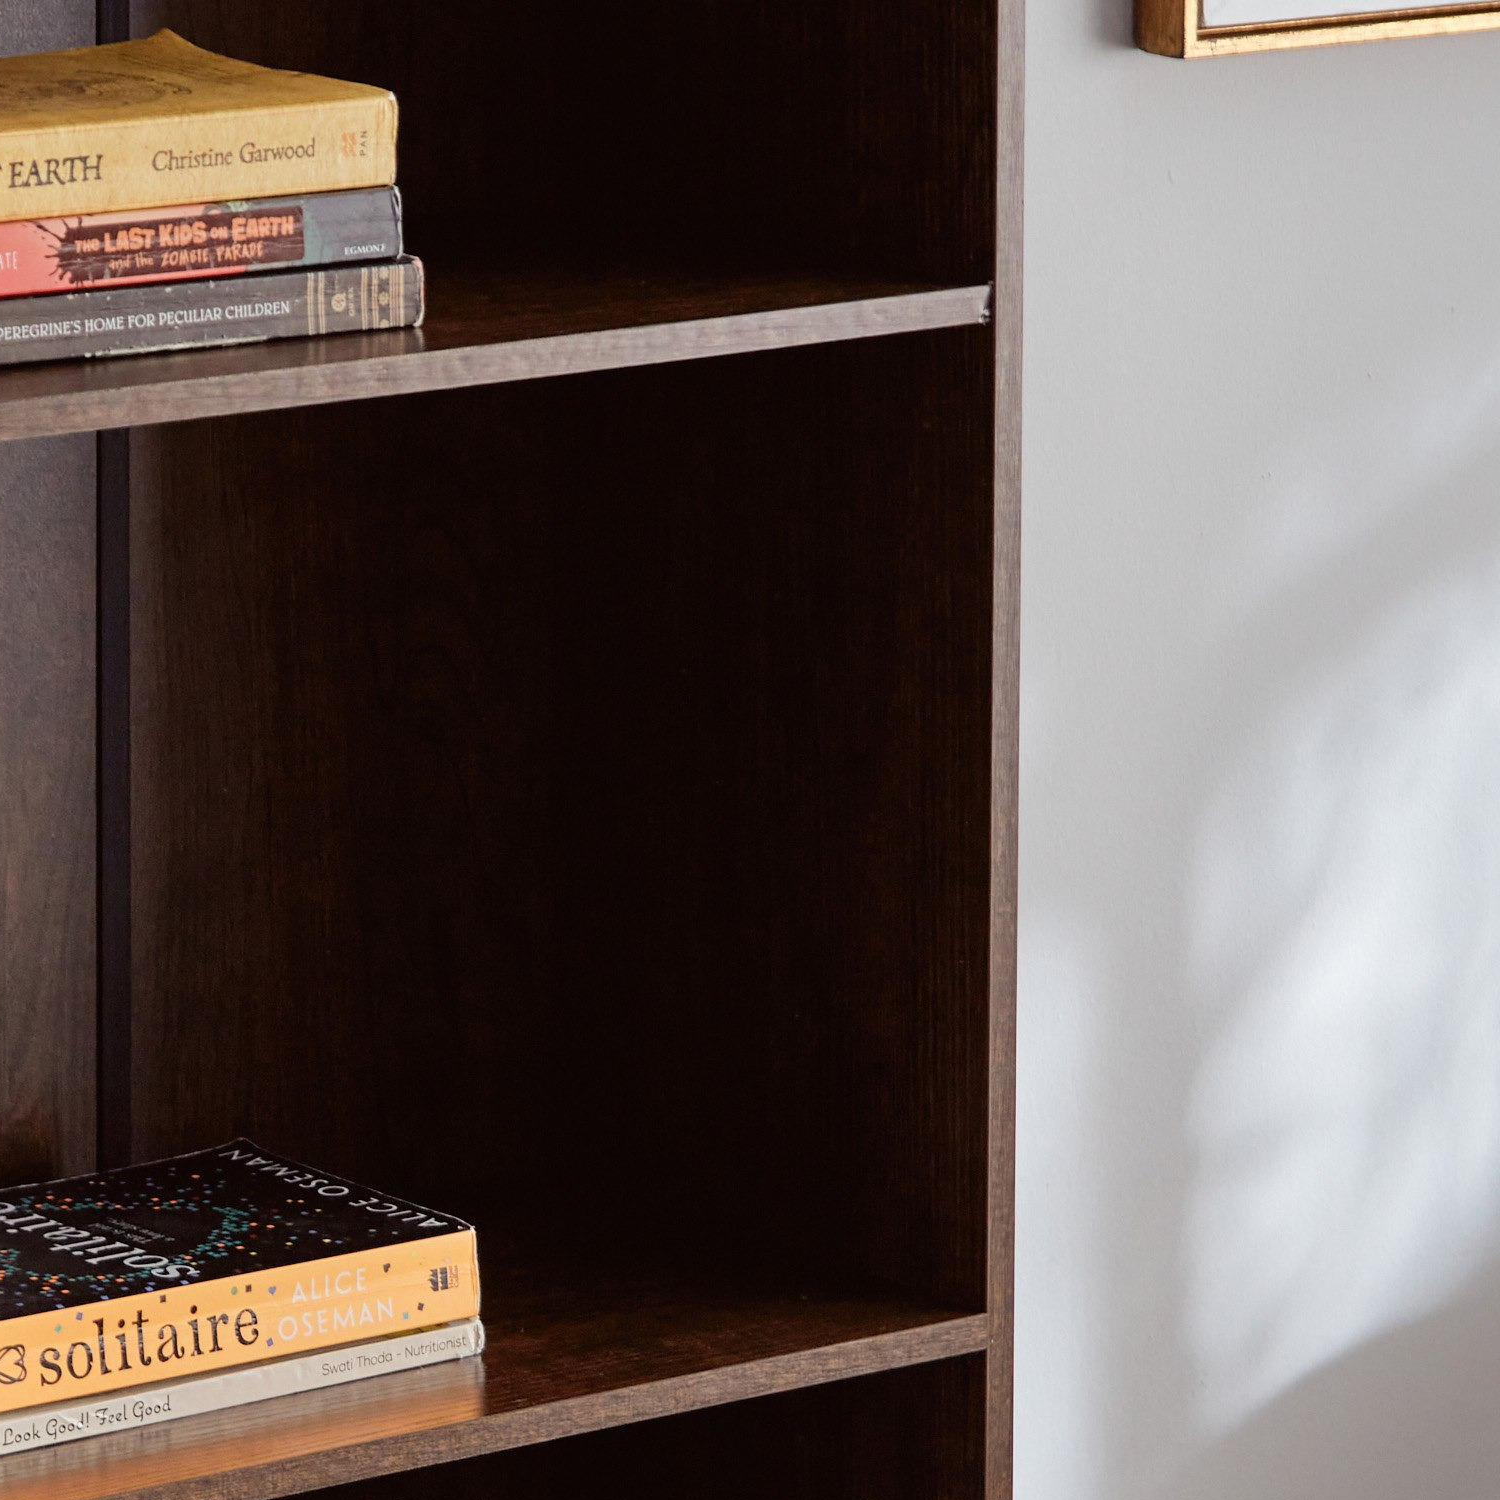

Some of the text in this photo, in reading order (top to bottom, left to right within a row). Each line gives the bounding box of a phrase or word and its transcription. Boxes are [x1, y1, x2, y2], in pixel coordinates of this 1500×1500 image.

[152, 138, 315, 171] Christine Garwood
[360, 130, 368, 156] PAN
[8, 154, 103, 189] EARTH
[103, 227, 156, 252] LAST
[231, 215, 294, 243] EARTH
[161, 249, 209, 268] ZOMBIE
[216, 241, 264, 262] PARADE
[84, 315, 124, 333] HOME
[128, 313, 155, 329] FOR
[158, 306, 222, 326] PECULIAR
[225, 300, 290, 320] CHILDREN
[218, 1149, 448, 1228] ALICE OSEMAN
[292, 1267, 367, 1304] ALICE
[278, 1297, 394, 1341] OSEMAN
[40, 1304, 259, 1387] solitaire
[321, 1360, 354, 1377] Swati
[356, 1352, 393, 1369] Thoda
[404, 1335, 467, 1358] Nutritionist
[2, 1395, 172, 1446] Look Good! Feel Good
